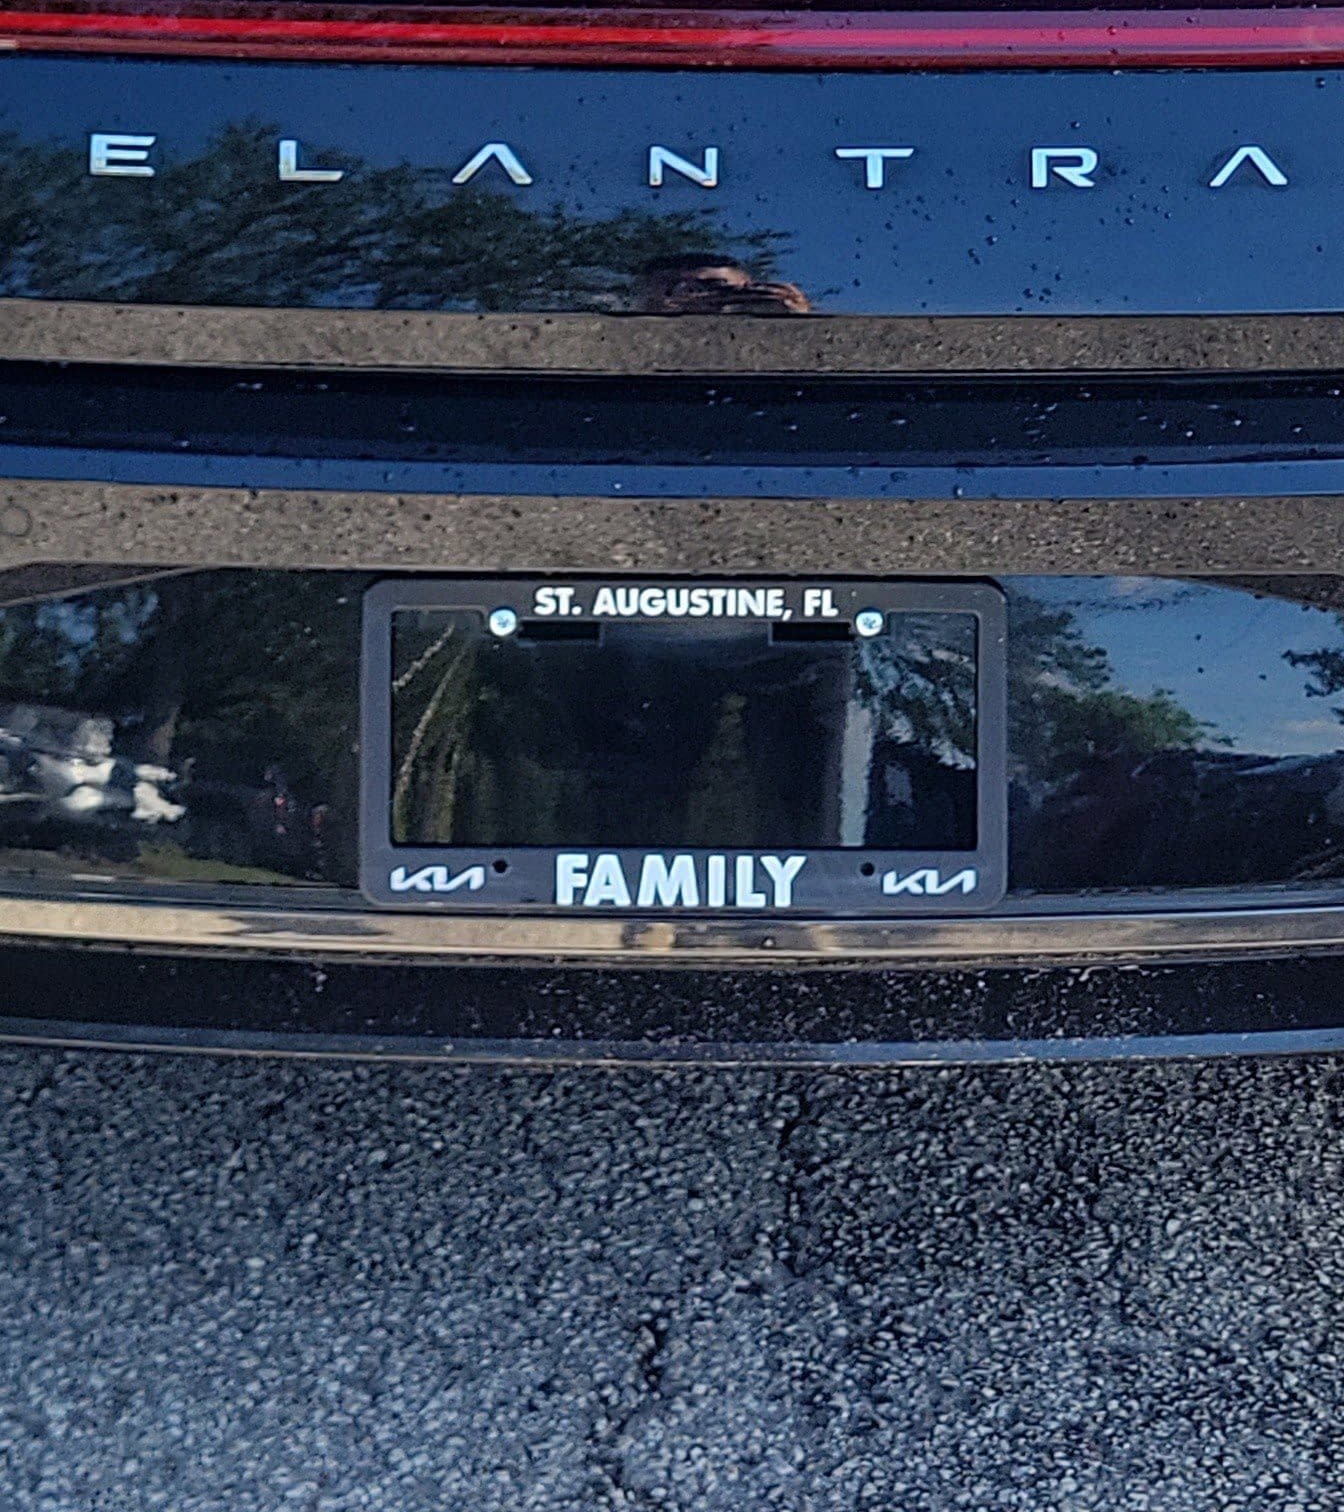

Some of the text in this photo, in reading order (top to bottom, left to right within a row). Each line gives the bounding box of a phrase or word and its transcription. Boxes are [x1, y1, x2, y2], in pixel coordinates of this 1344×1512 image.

[89, 133, 1289, 189] ELANTRA
[534, 587, 838, 620] ST. AUGUSTINE, FL
[389, 865, 485, 892] KIA
[555, 853, 807, 908] FAMILY
[882, 867, 977, 895] KIA
